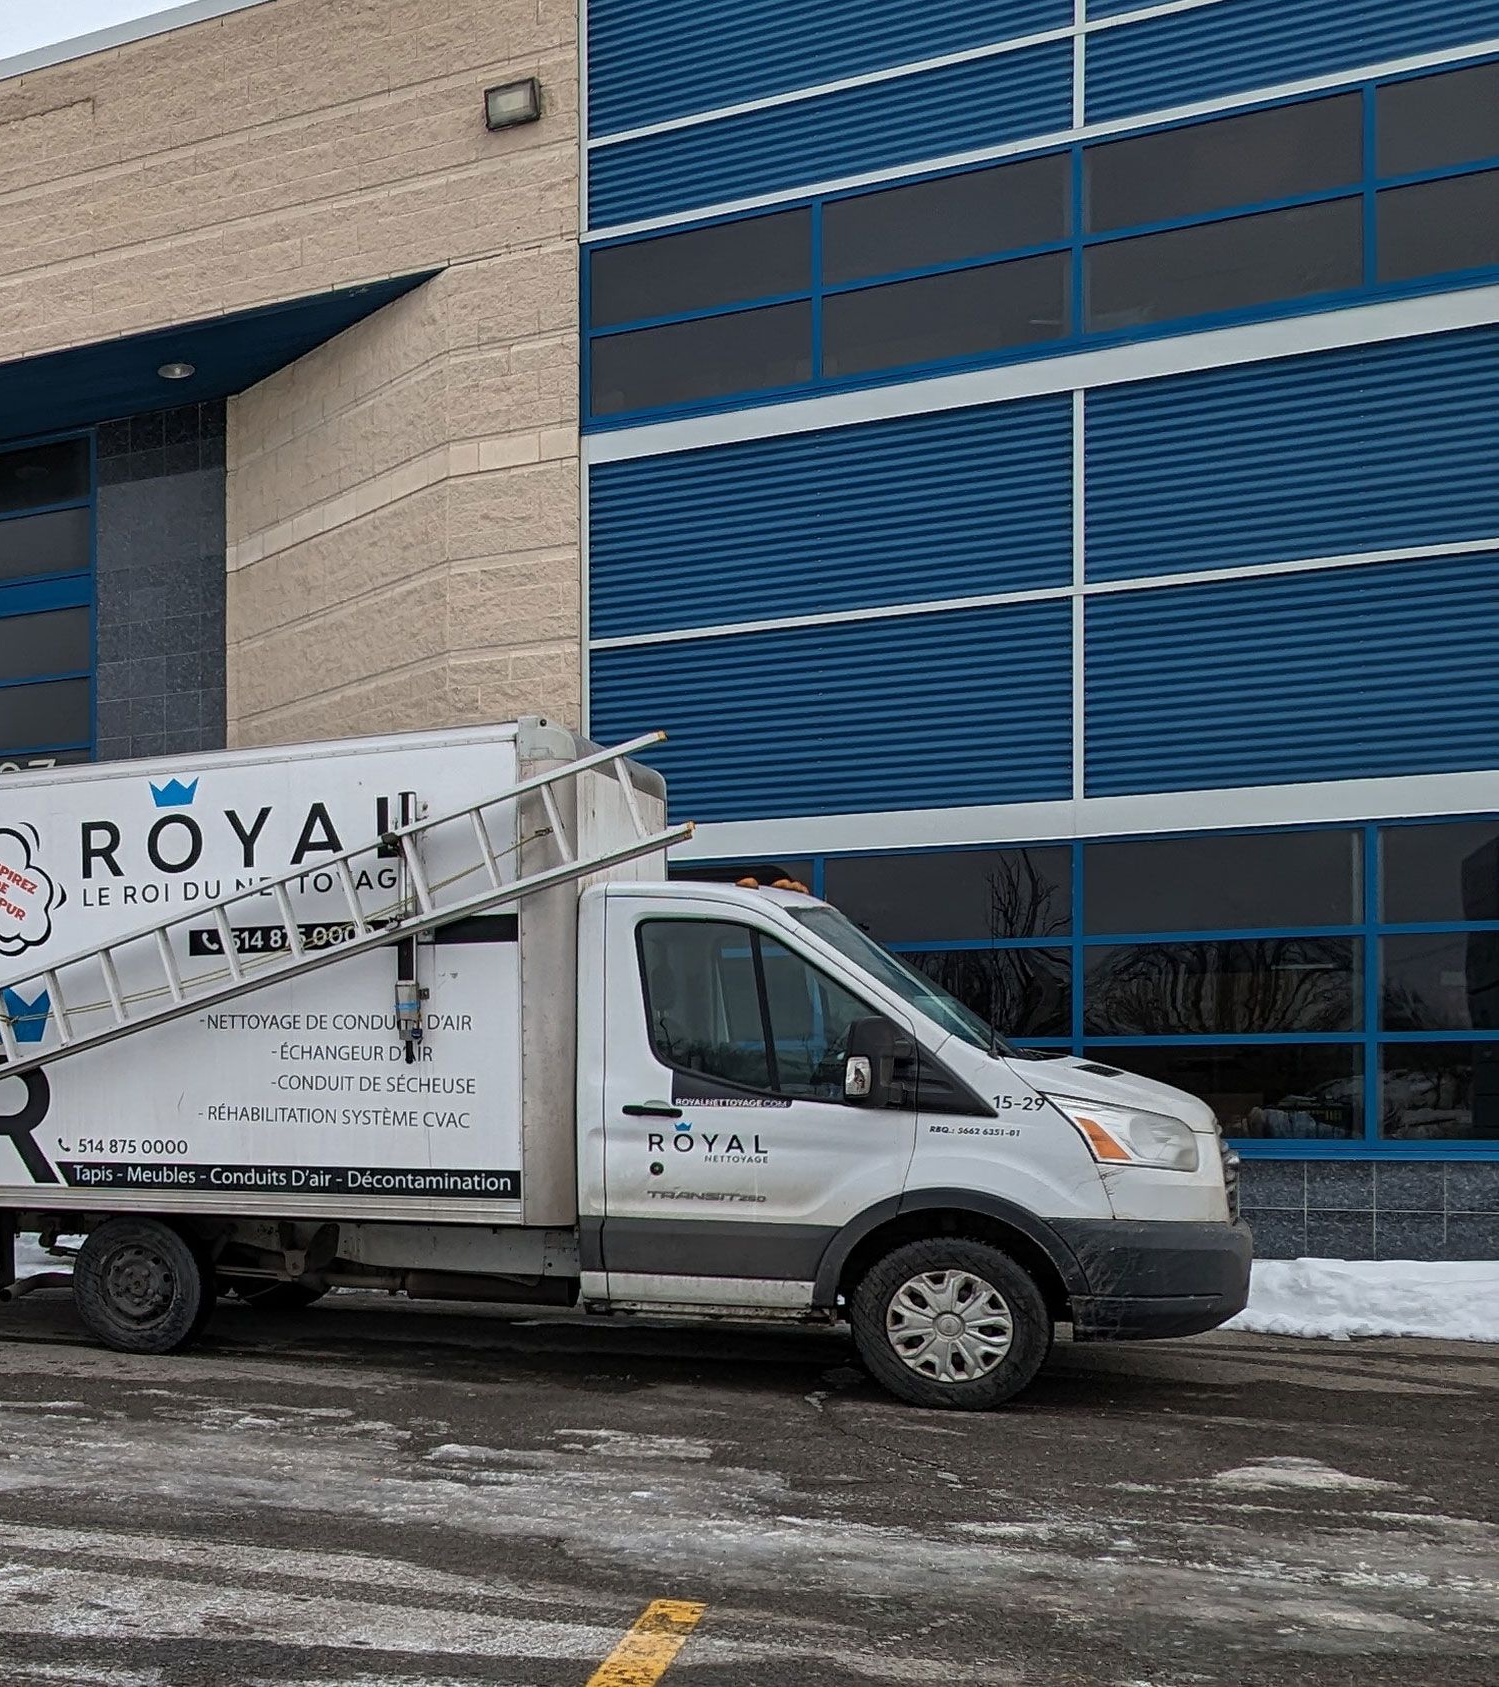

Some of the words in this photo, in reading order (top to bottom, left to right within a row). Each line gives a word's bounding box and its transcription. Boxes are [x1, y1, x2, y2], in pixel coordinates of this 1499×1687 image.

[80, 796, 399, 880] ROYAL
[83, 886, 110, 907] LE
[123, 884, 169, 905] ROI
[183, 880, 221, 902] DU
[232, 931, 264, 950] 514
[306, 1014, 328, 1031] DE
[427, 1015, 472, 1031] D'AIR
[389, 1046, 433, 1062] D'IR
[359, 1076, 381, 1092] DE
[386, 1074, 476, 1094] SÉCHEUSE
[992, 1095, 1045, 1111] 15-29
[207, 1103, 337, 1124] RÉHABILITATION
[342, 1107, 419, 1127] SYSTÈME
[423, 1111, 471, 1129] CVAC
[78, 1138, 105, 1153] 514
[109, 1139, 137, 1154] 875
[141, 1139, 188, 1154] 0000
[647, 1133, 769, 1154] ROYAL
[704, 1155, 769, 1164] NETTOYAGE
[73, 1165, 113, 1184] Tapis
[127, 1166, 196, 1184] Meubles
[210, 1167, 287, 1186] Conduits
[292, 1170, 332, 1187] D'air
[348, 1170, 511, 1191] Décontamination
